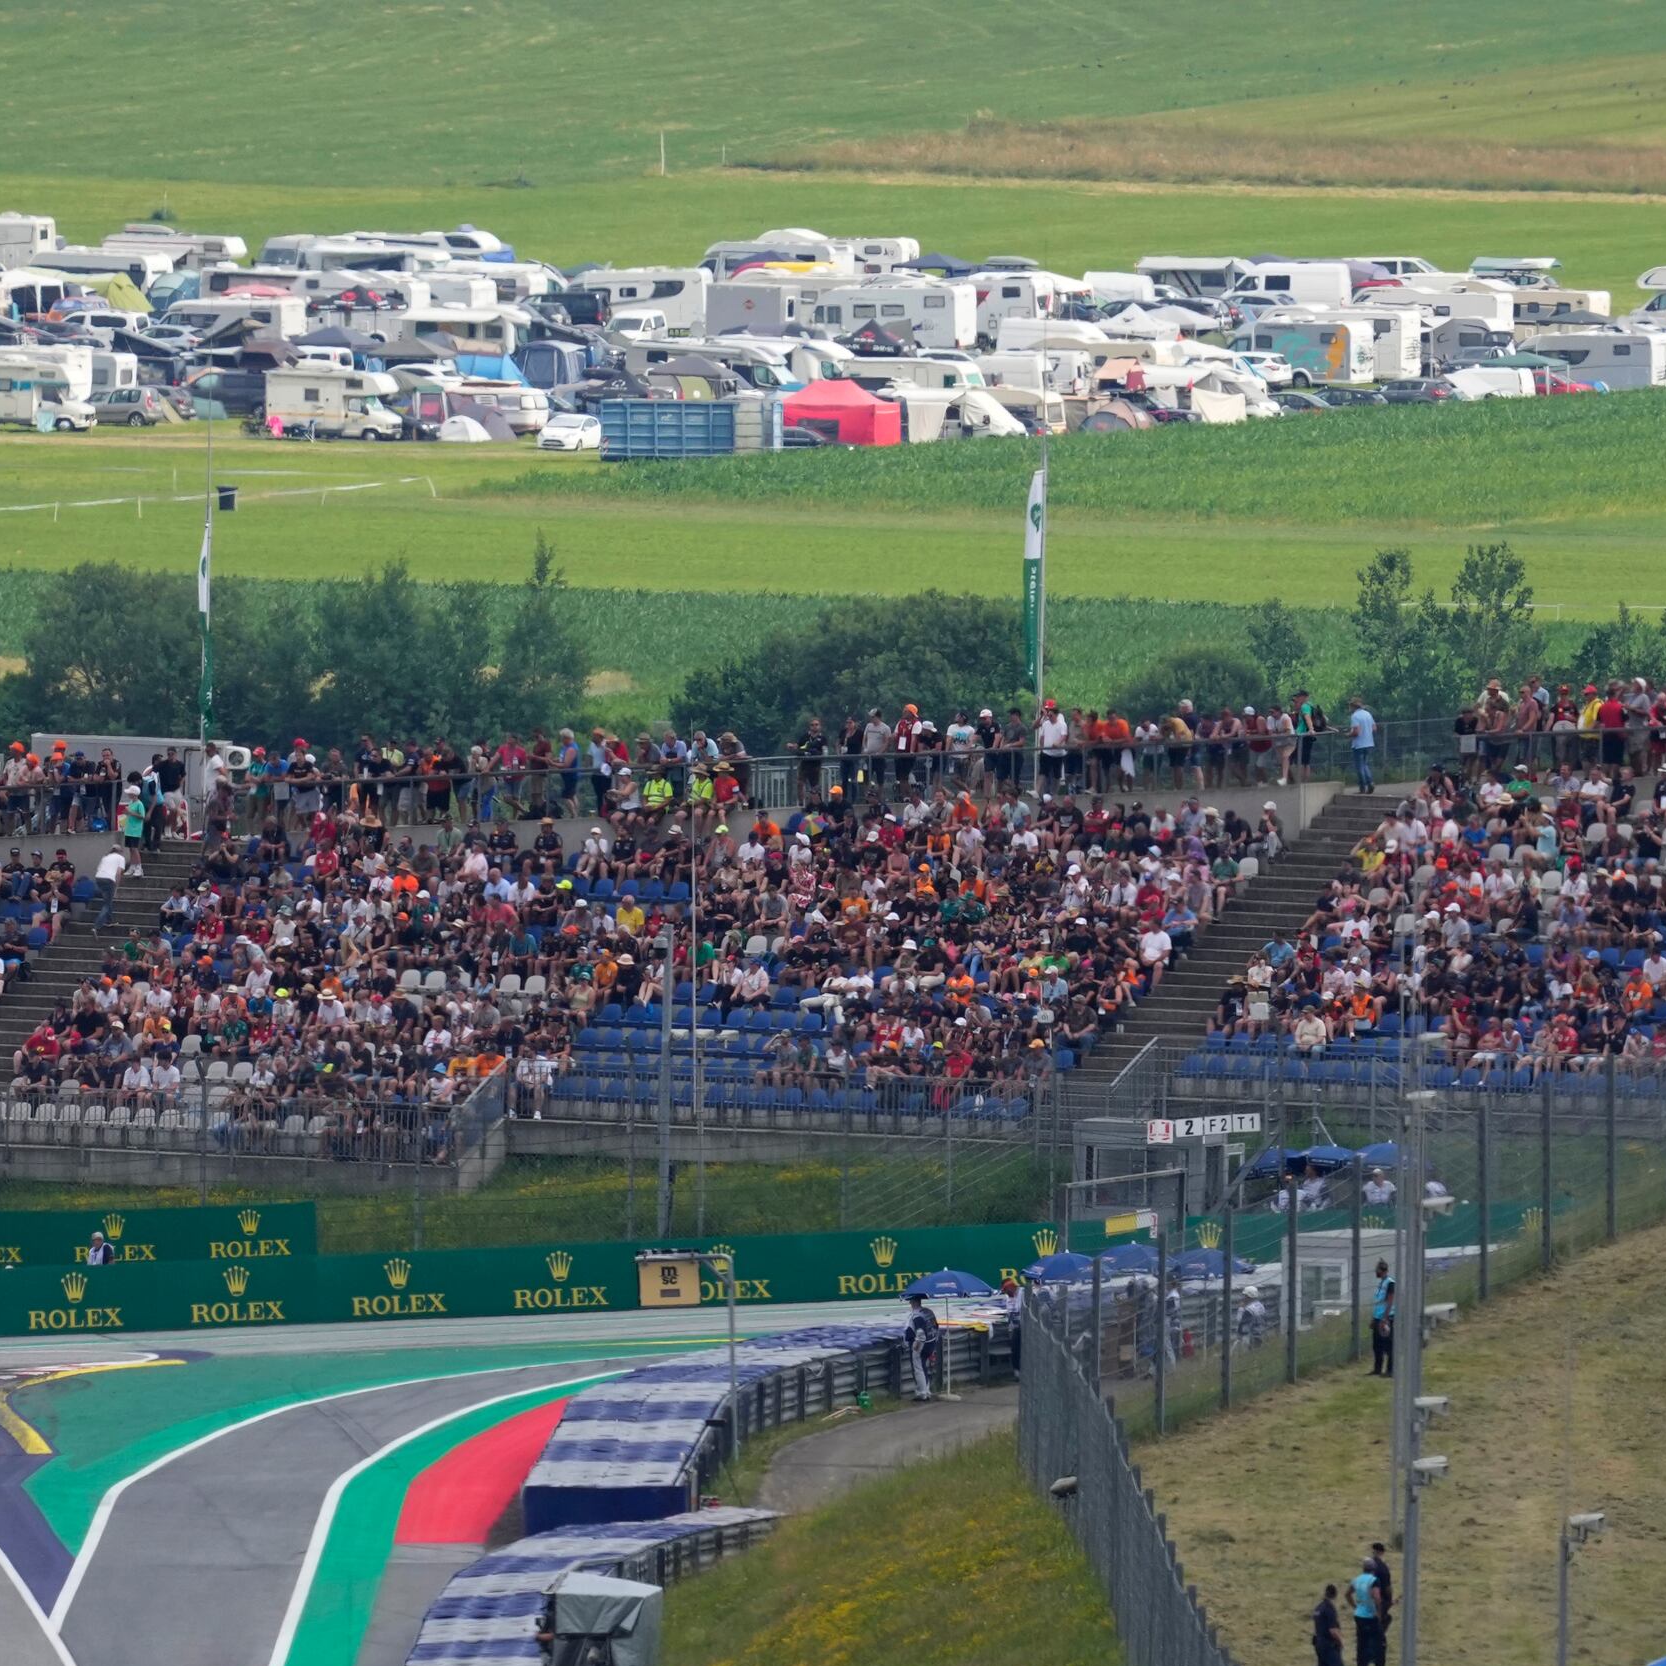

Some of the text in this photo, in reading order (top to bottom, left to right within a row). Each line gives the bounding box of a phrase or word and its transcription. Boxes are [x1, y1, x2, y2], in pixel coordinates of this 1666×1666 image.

[1185, 1120, 1194, 1136] 2
[209, 1239, 291, 1259] ROLEX
[514, 1286, 608, 1309] ROLEX
[699, 1279, 771, 1301] OLEX
[191, 1300, 285, 1323] ROLEX
[352, 1294, 446, 1317] ROLEX
[28, 1307, 124, 1330] ROLEX
